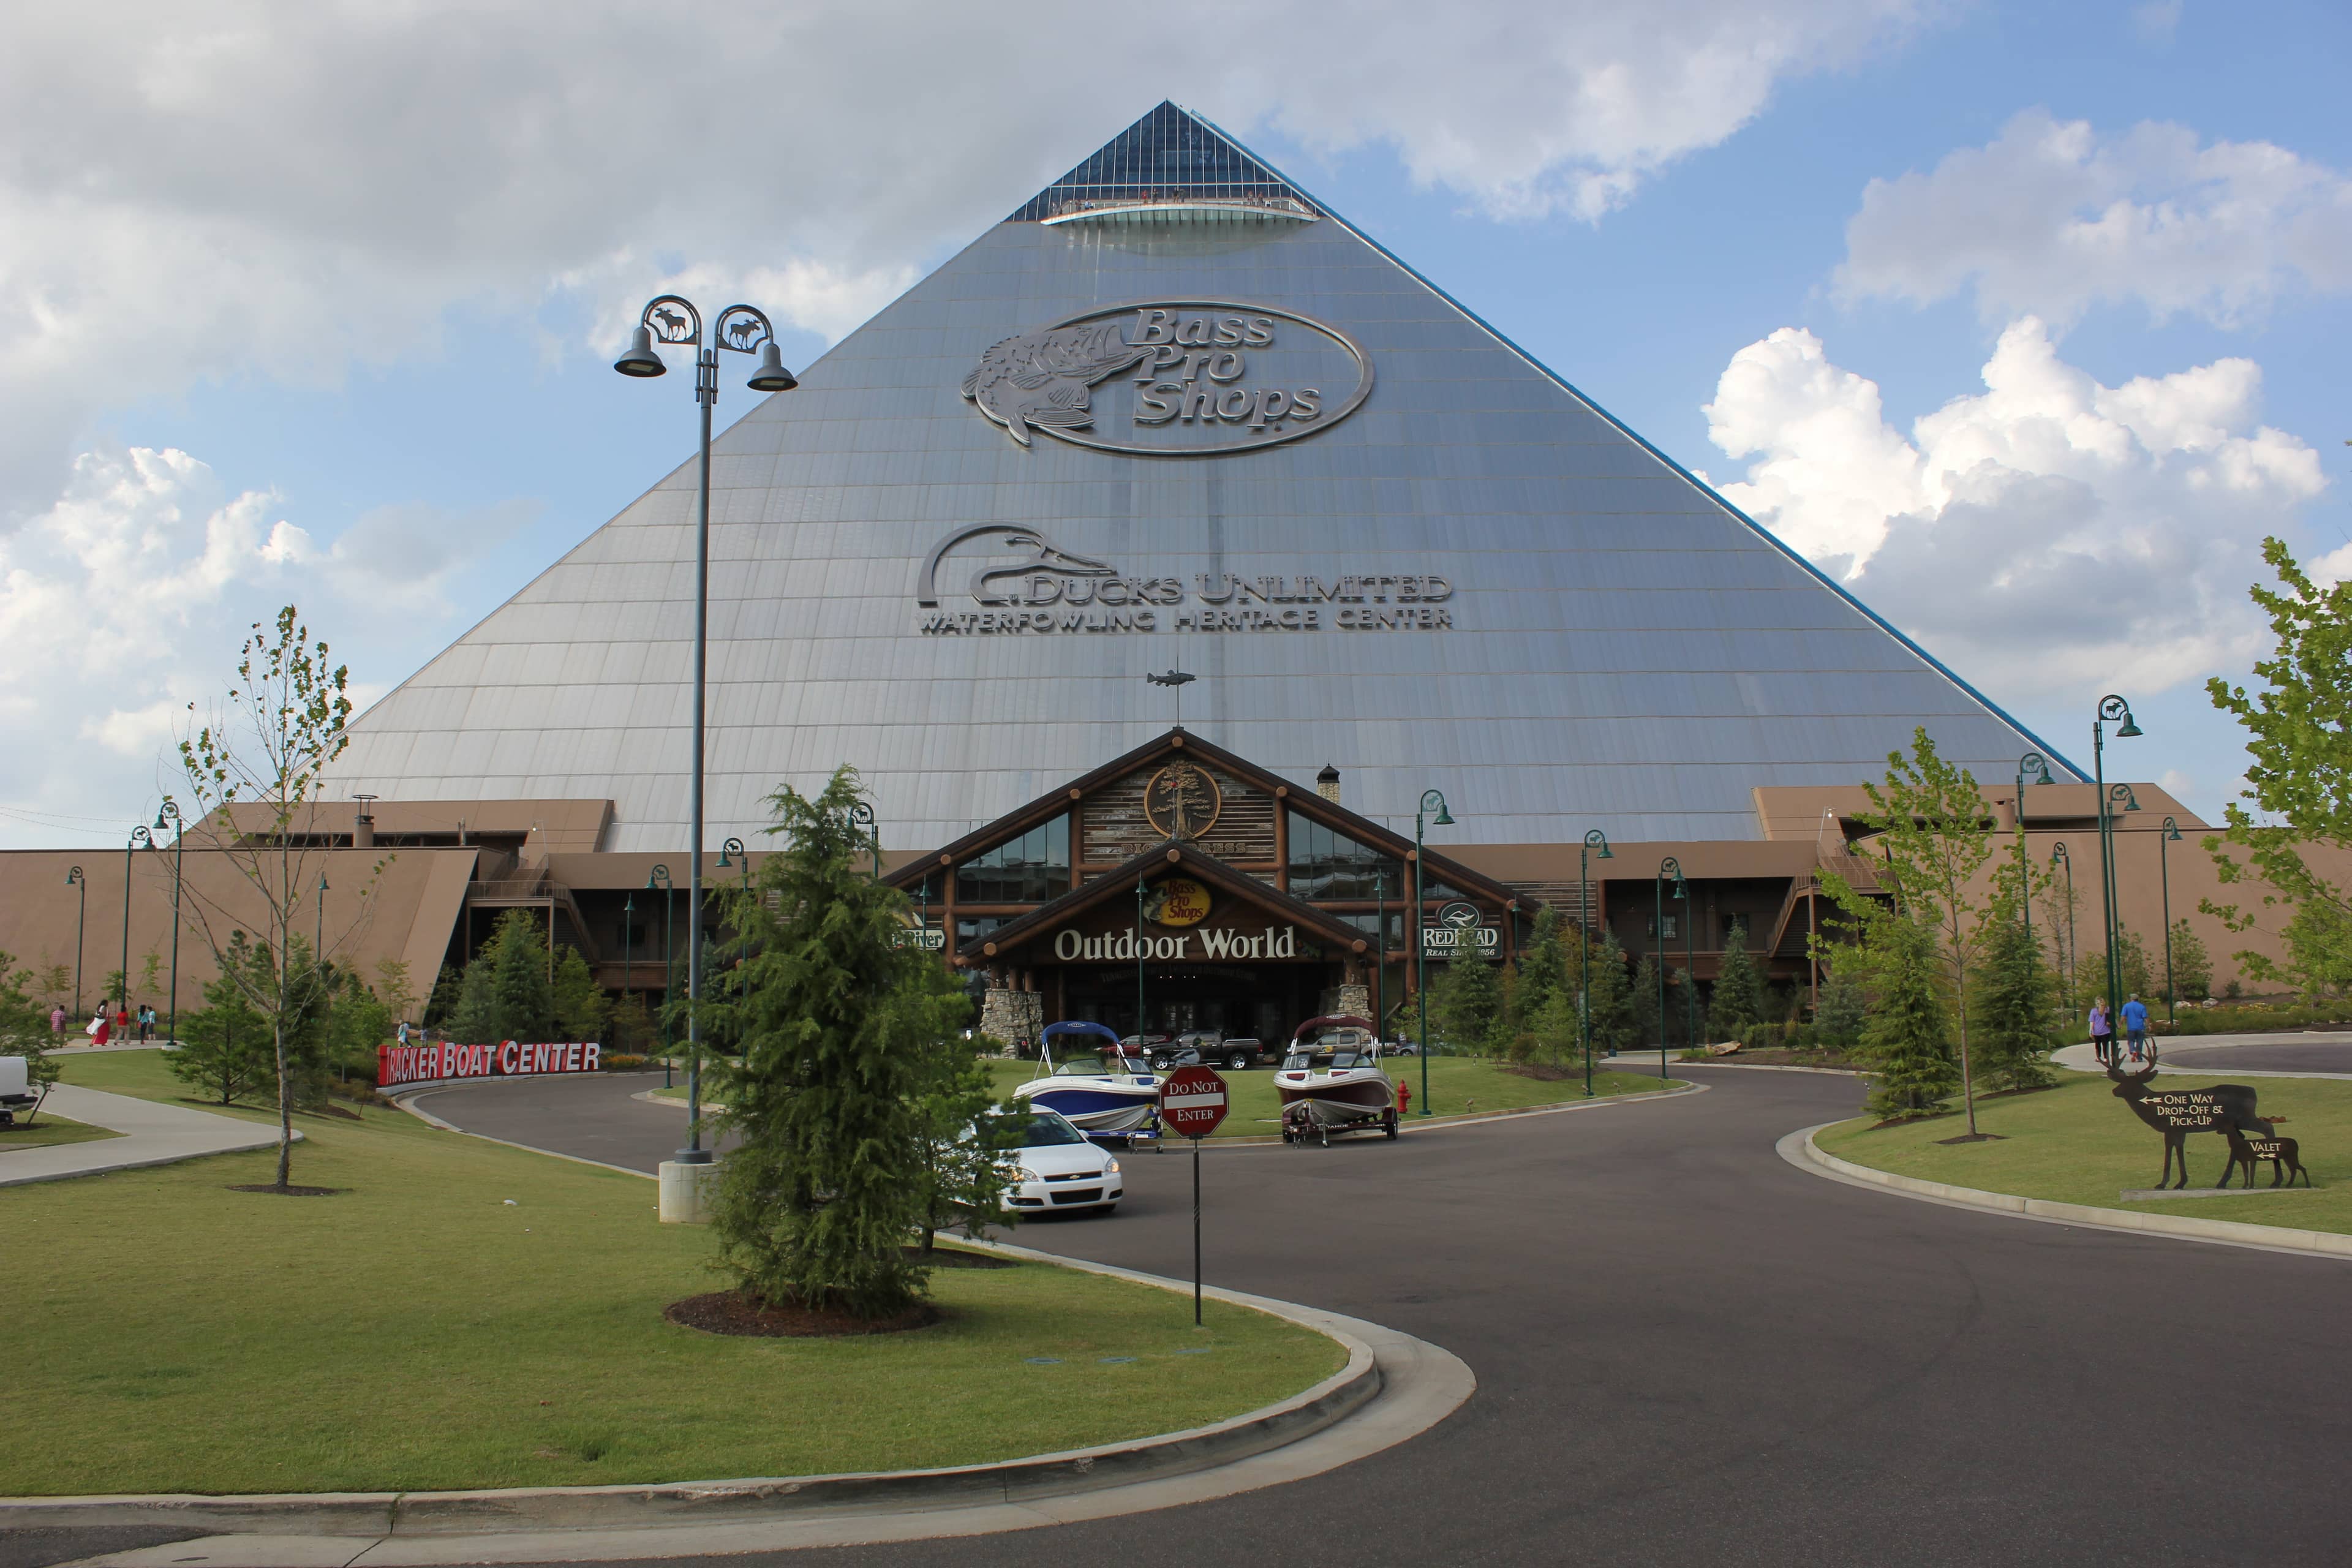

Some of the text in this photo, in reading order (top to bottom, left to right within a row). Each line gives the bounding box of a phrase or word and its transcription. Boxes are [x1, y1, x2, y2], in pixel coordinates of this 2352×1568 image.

[1125, 308, 1275, 347] Bass
[1133, 345, 1245, 382] Pro
[1133, 382, 1322, 428] Shops
[1023, 573, 1452, 605] DUCKS UNLIMITED
[919, 609, 1452, 632] WATERFOWLING HERITAGE CENTER
[1167, 880, 1196, 894] Bass
[1168, 894, 1189, 907] Pro
[1169, 905, 1204, 921] Shops
[1054, 926, 1297, 961] Outdoor World
[1423, 929, 1498, 946] REDHAD
[381, 1040, 600, 1085] TRACKER BOAT CENTER
[1169, 1081, 1218, 1095] DO NOT
[2164, 1094, 2214, 1104] ONE WAY
[1177, 1109, 1213, 1121] ENTER
[2157, 1105, 2224, 1116] DROP-OFF &
[2170, 1116, 2212, 1126] PICK-UP
[2250, 1142, 2281, 1152] VALET
